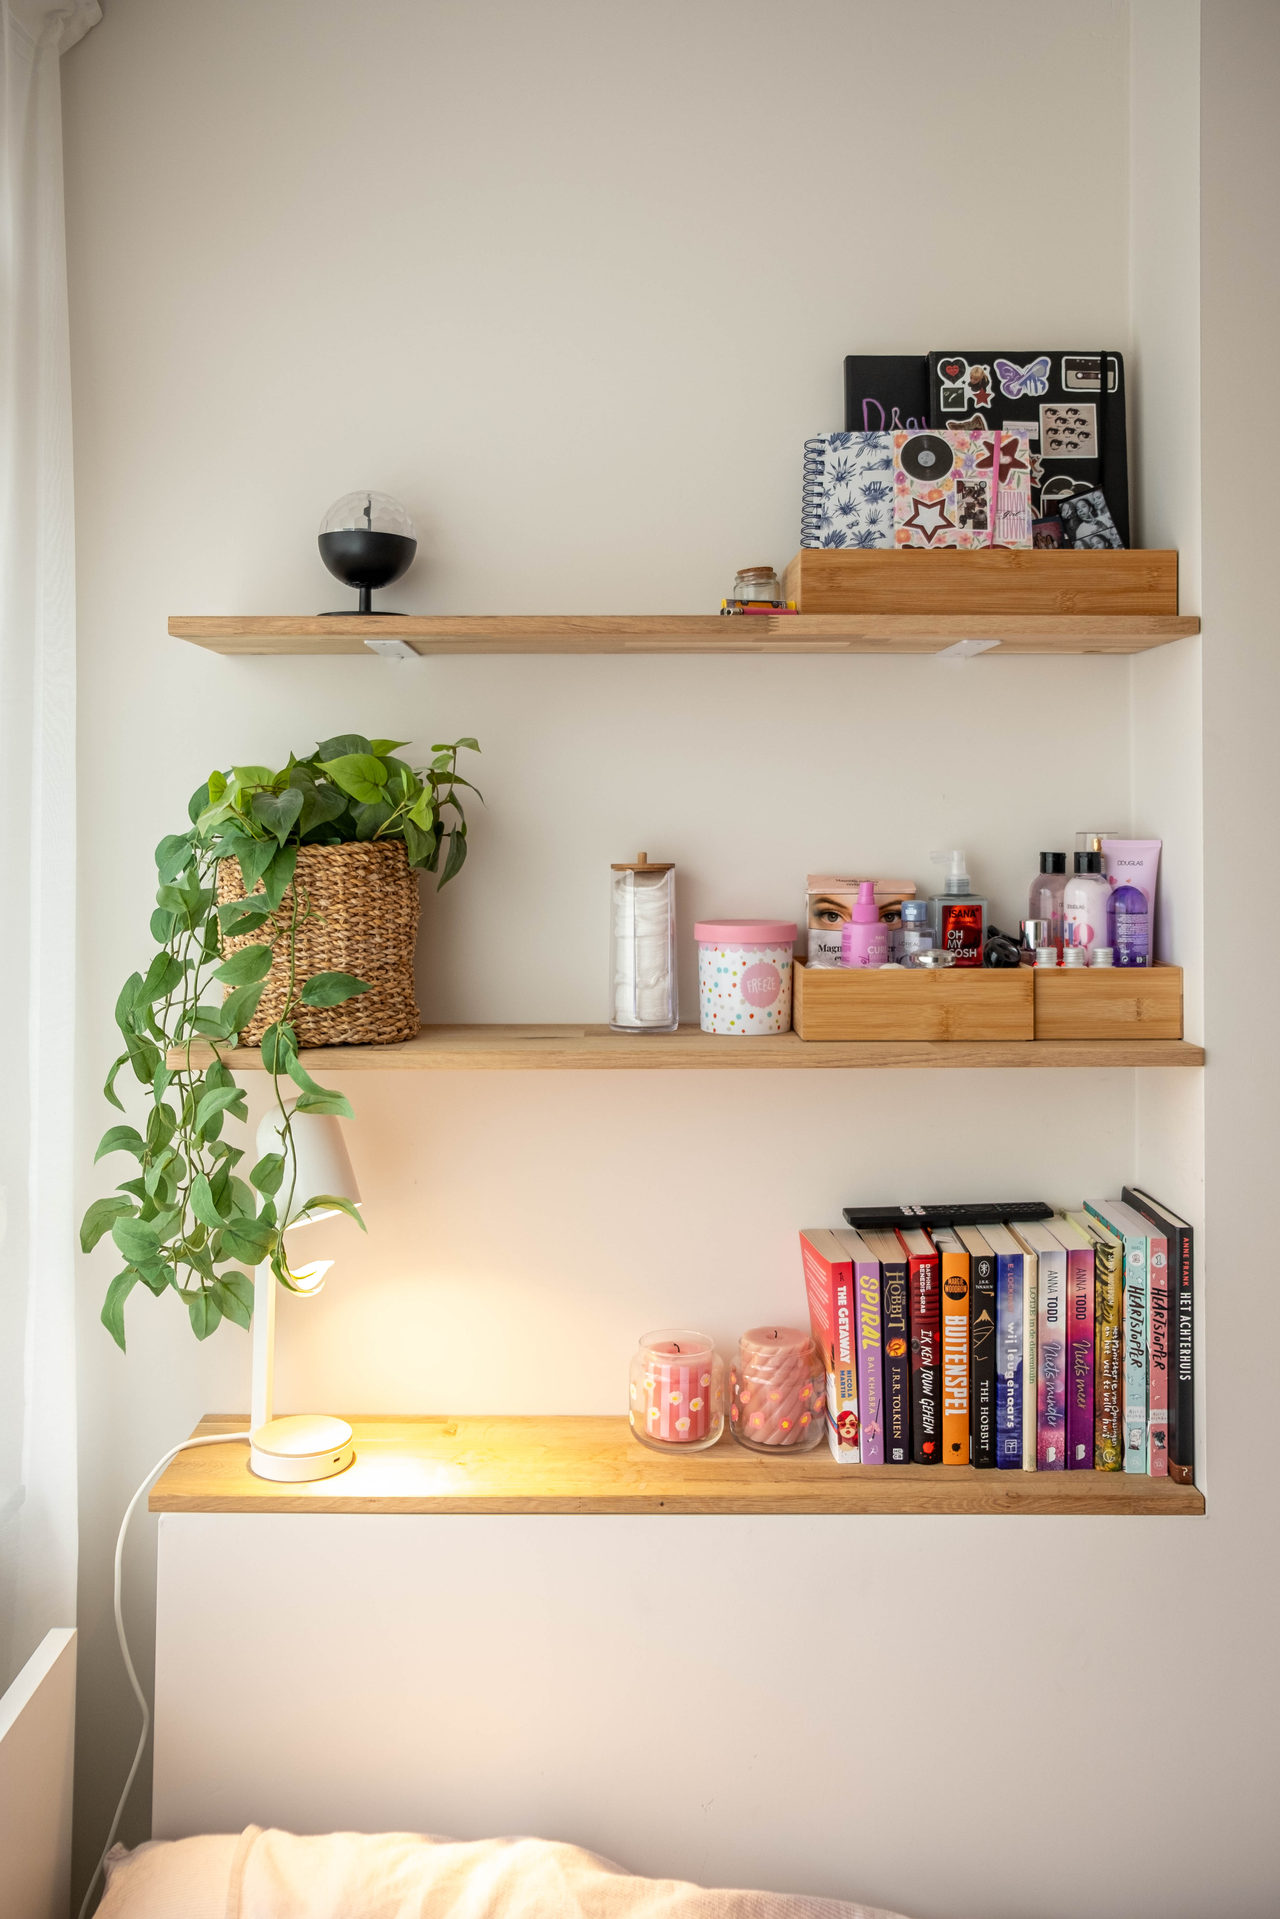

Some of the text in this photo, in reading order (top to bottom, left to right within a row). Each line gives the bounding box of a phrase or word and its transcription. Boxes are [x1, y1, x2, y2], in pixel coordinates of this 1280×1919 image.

[947, 930, 963, 940] OH
[947, 940, 962, 949] MY
[746, 976, 777, 993] FREEZE
[1182, 1237, 1190, 1287] ANNE FRANK
[837, 1285, 848, 1306] THE
[860, 1275, 881, 1350] SPIRAL
[885, 1271, 906, 1332] HOBBIT
[1046, 1270, 1059, 1323] ANNA TODD
[1075, 1268, 1087, 1321] ANNA TODD
[837, 1307, 851, 1364] GETAWAY
[1029, 1328, 1036, 1340] de
[1127, 1285, 1145, 1369] HEARTSTOPPER
[1151, 1287, 1168, 1371] HEARTSTOPPER
[1179, 1292, 1191, 1381] HET ACHTERHUIS
[839, 1370, 847, 1399] MARTIN
[846, 1369, 854, 1398] NICOLA
[867, 1356, 876, 1415] BAL KHABRA
[918, 1329, 935, 1435] IK KEN JOUW GEHEIM
[944, 1315, 968, 1417] BUITENSPEL
[1004, 1321, 1018, 1429] wij leugenaars
[1029, 1341, 1037, 1385] dierentuin
[1042, 1342, 1064, 1428] Niets minder
[1072, 1340, 1091, 1409] Niets meer
[892, 1367, 902, 1440] J.R.R. TOLKIEN
[980, 1380, 989, 1403] THE
[980, 1406, 990, 1451] HOBBIT
